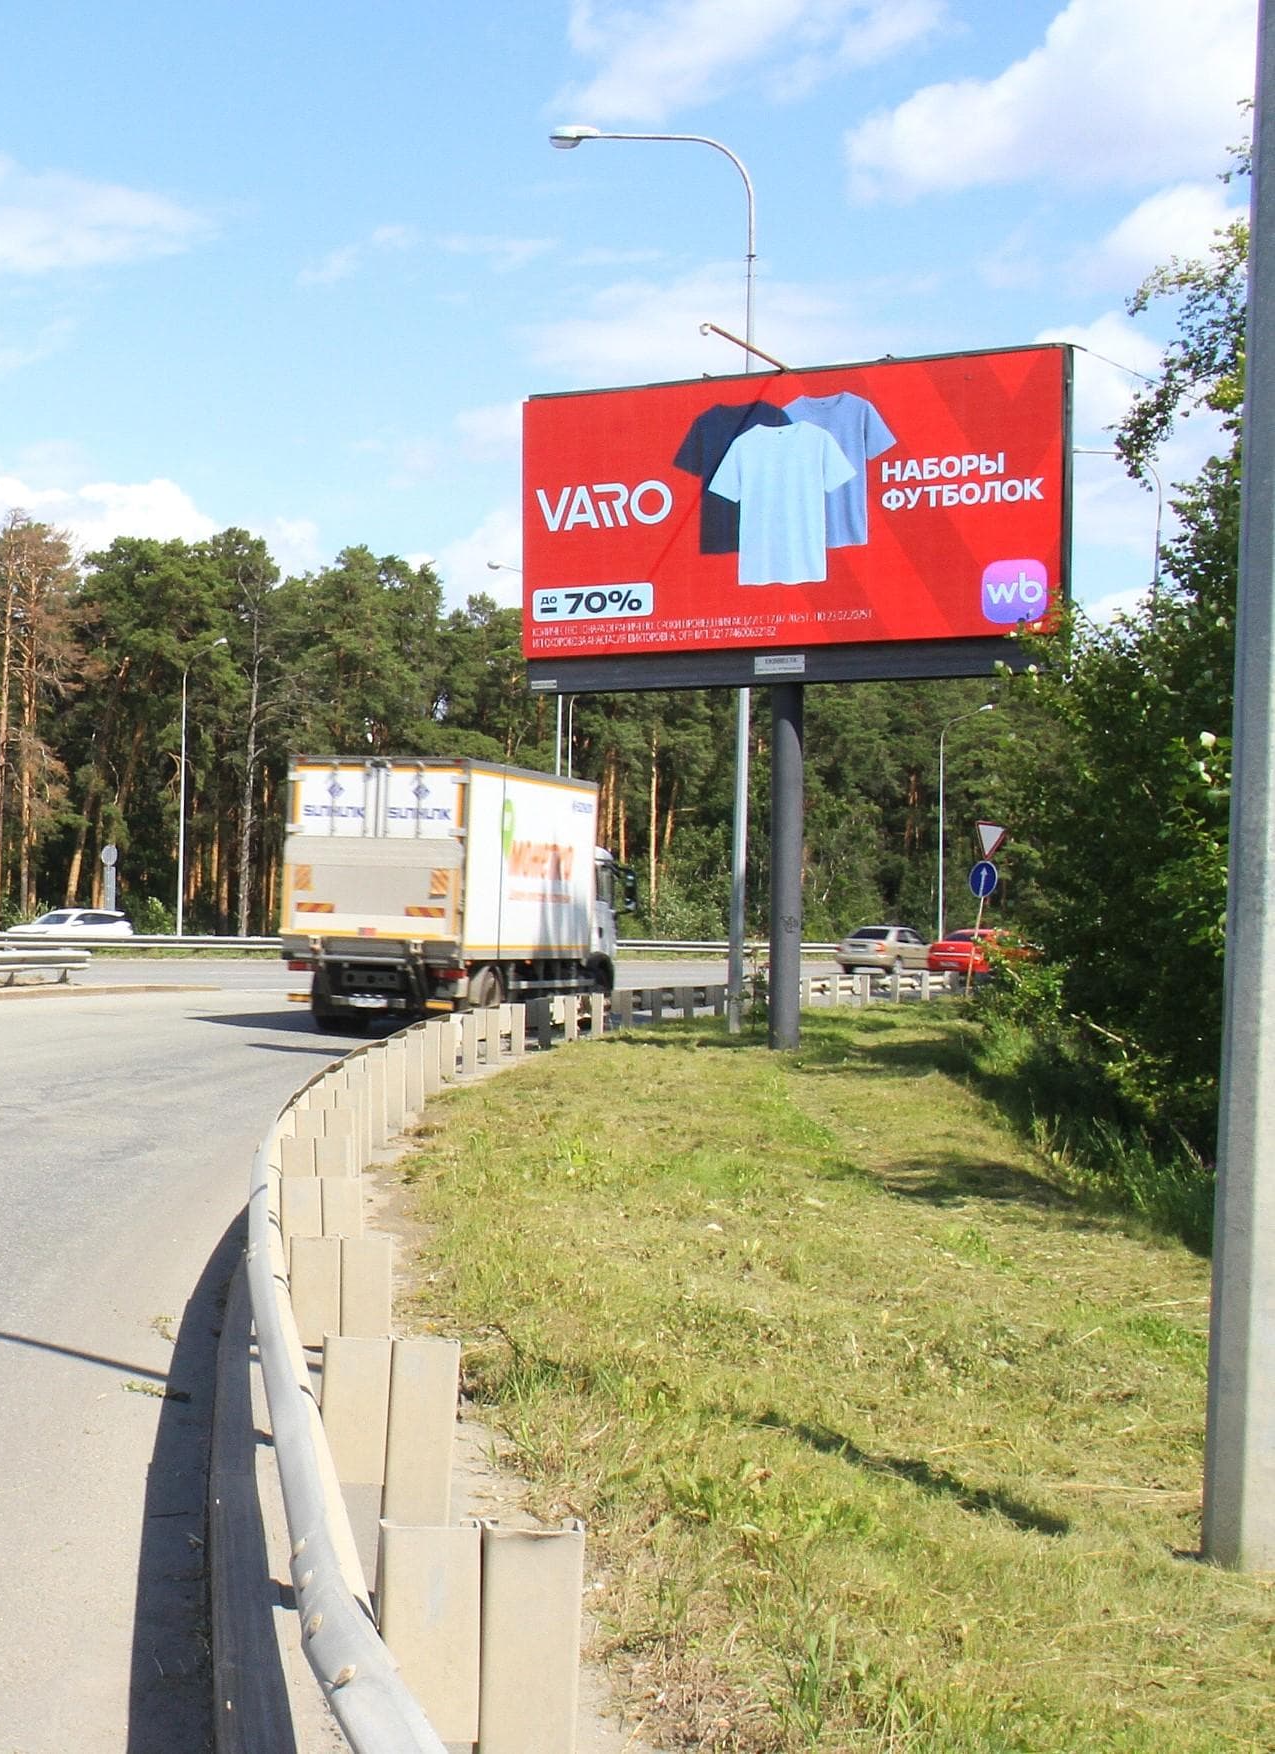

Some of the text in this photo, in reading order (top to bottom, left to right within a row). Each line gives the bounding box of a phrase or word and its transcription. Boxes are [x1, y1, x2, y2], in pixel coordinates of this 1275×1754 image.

[881, 452, 1005, 483] НАБОРЫ
[535, 480, 673, 532] VARO
[881, 477, 1045, 511] ФУТБОЛОК
[986, 572, 1044, 605] wb
